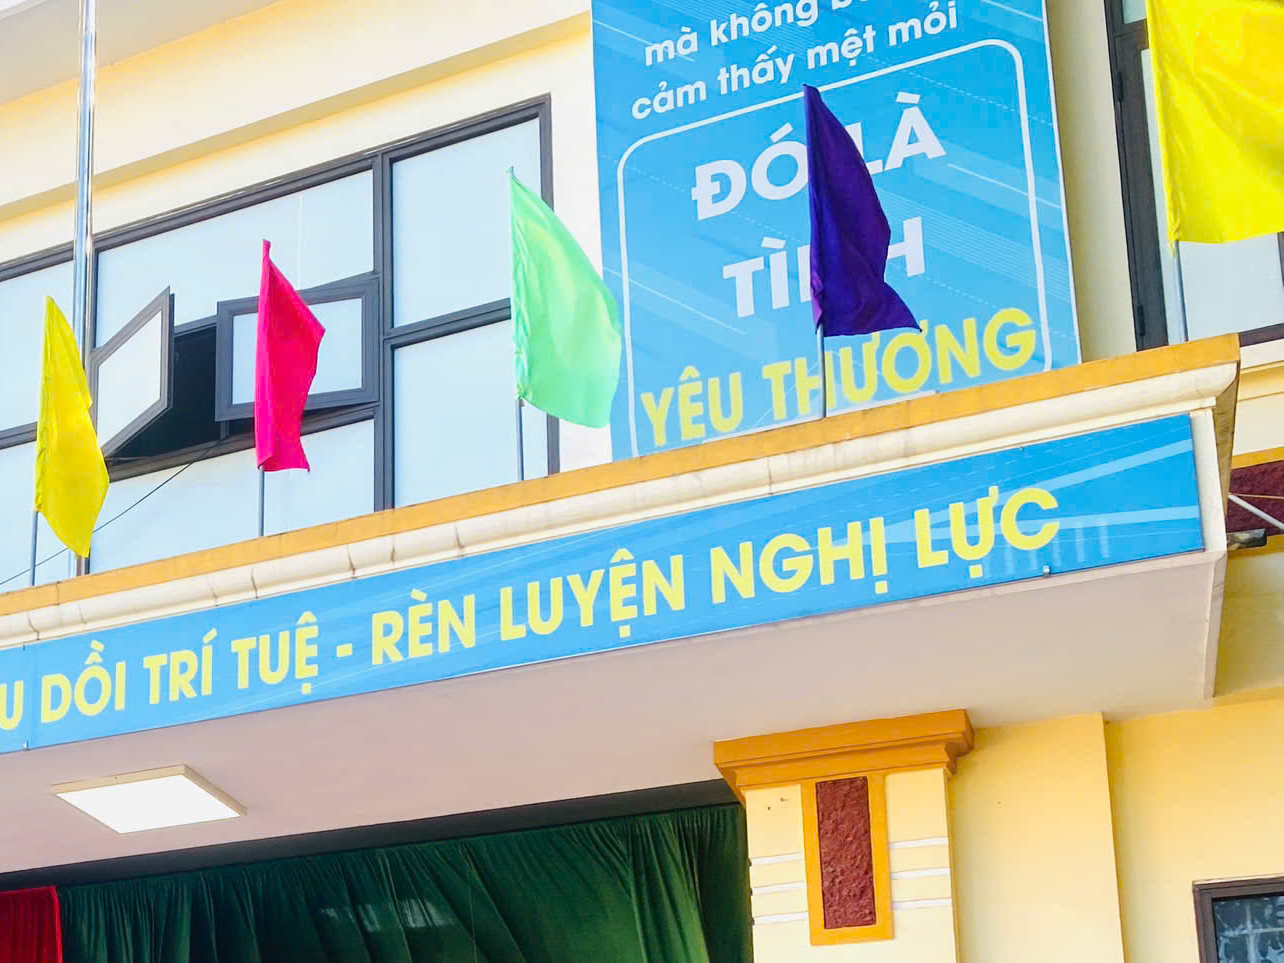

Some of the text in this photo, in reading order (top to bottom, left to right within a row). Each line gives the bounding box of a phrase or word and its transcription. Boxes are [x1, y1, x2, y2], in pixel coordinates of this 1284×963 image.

[631, 1, 958, 120] cảm thấy mệt mỏi
[645, 0, 819, 66] mà không
[691, 122, 809, 221] ĐÓ
[722, 216, 926, 318] TÌH
[641, 308, 1036, 447] YÊU THƯƠNG
[40, 639, 126, 724] DỒI
[143, 627, 218, 700] TRÍ
[231, 611, 320, 695] TUỆ
[335, 642, 354, 660] -
[371, 589, 477, 666] RÈN
[500, 547, 686, 641] LUYỆN
[710, 516, 888, 605] NGHỊ
[915, 485, 1061, 579] LỰC
